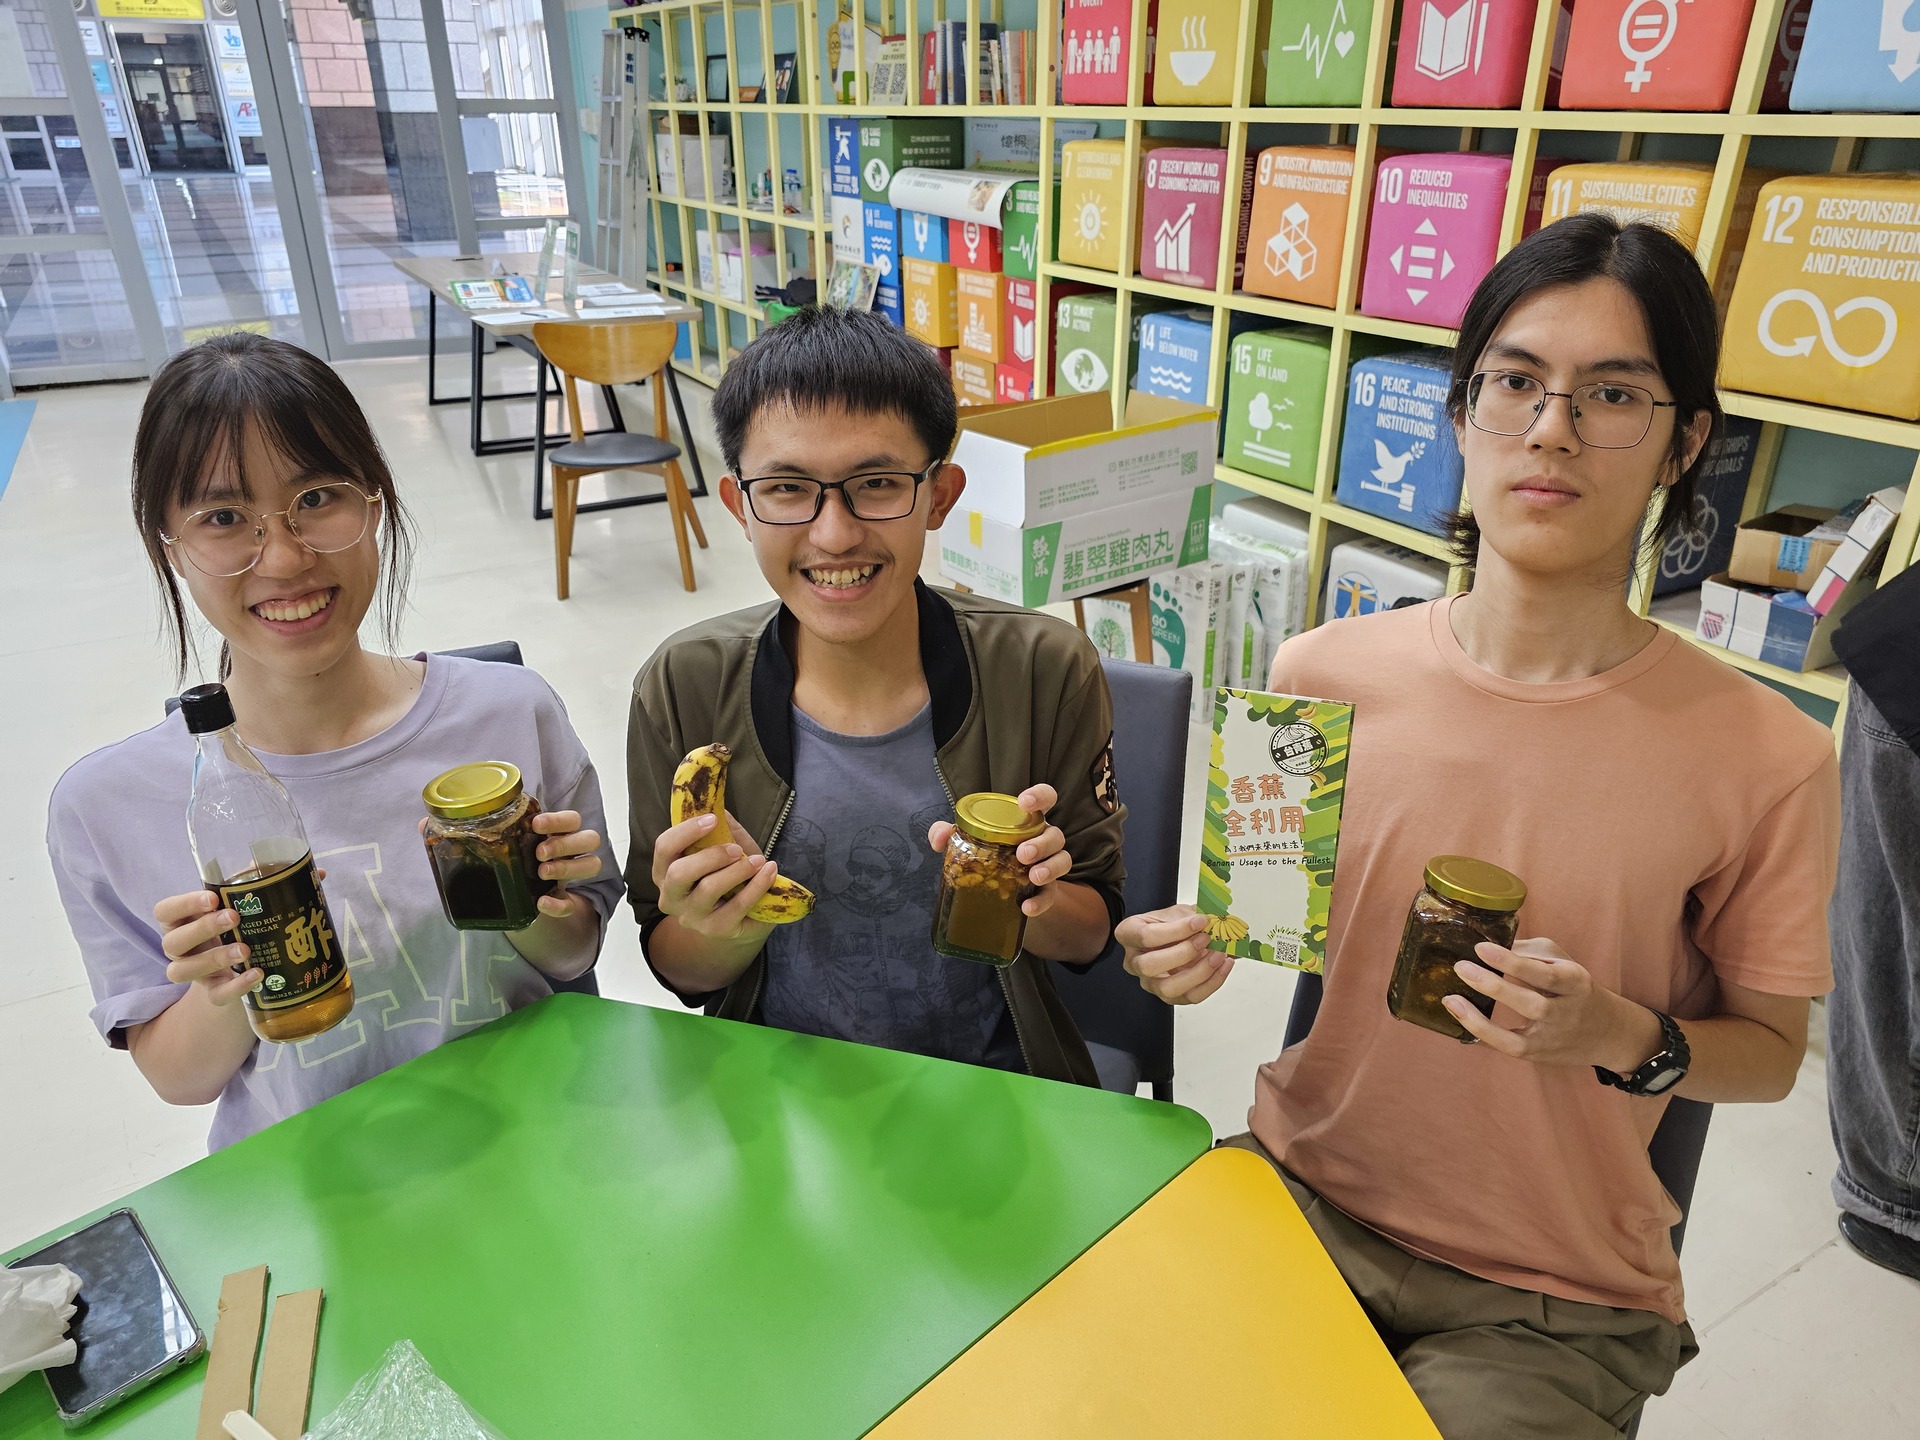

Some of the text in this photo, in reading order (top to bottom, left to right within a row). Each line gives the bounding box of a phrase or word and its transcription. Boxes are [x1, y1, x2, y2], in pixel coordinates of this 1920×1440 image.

[1065, 151, 1072, 178] 7
[1147, 159, 1157, 189] 8
[1160, 159, 1219, 177] DECENT WORK AND
[1259, 152, 1272, 186] 9
[1275, 156, 1354, 176] INDUSTRY, INNOVATION
[1158, 176, 1220, 195] ECONOMIC GROWTH
[1241, 157, 1255, 201] GROWTH
[1272, 173, 1350, 195] AND INFRASTRUCTURE
[1380, 167, 1403, 204] 10
[1409, 168, 1452, 188] REDUCED
[1006, 189, 1013, 211] 3
[1406, 189, 1468, 210] INEQUALITIES
[1551, 179, 1573, 217] 11
[1580, 180, 1698, 207] SUSTAINABLE CITIES
[1237, 201, 1251, 254] ECONOMIC
[1762, 195, 1804, 244] 12
[1802, 252, 1838, 274] AND
[1008, 280, 1015, 305] 4
[1058, 303, 1070, 329] 13
[1073, 305, 1095, 320] CLIMATE
[1072, 316, 1091, 333] ACTION
[1160, 326, 1172, 341] LIFE
[1141, 322, 1155, 351] 14
[1159, 342, 1198, 363] BELOW WATER
[1234, 344, 1252, 375] 15
[1257, 347, 1272, 363] LIFE
[999, 374, 1005, 395] 1
[1256, 364, 1288, 383] ON LAND
[1355, 372, 1376, 407] 16
[1381, 375, 1411, 396] PEACE,
[1379, 394, 1435, 420] AND STRONG
[1376, 412, 1436, 440] INSTITUTIONS
[1063, 528, 1174, 581] 翡翠雞肉丸
[1152, 614, 1167, 629] GO
[1151, 626, 1180, 645] GREEN
[1231, 773, 1286, 803] 香蕉
[1222, 806, 1306, 837] 全利用
[1206, 856, 1331, 867] Banana Usage to the Fullest
[241, 914, 283, 929] AGED RICE
[242, 924, 280, 936] VINEGAR
